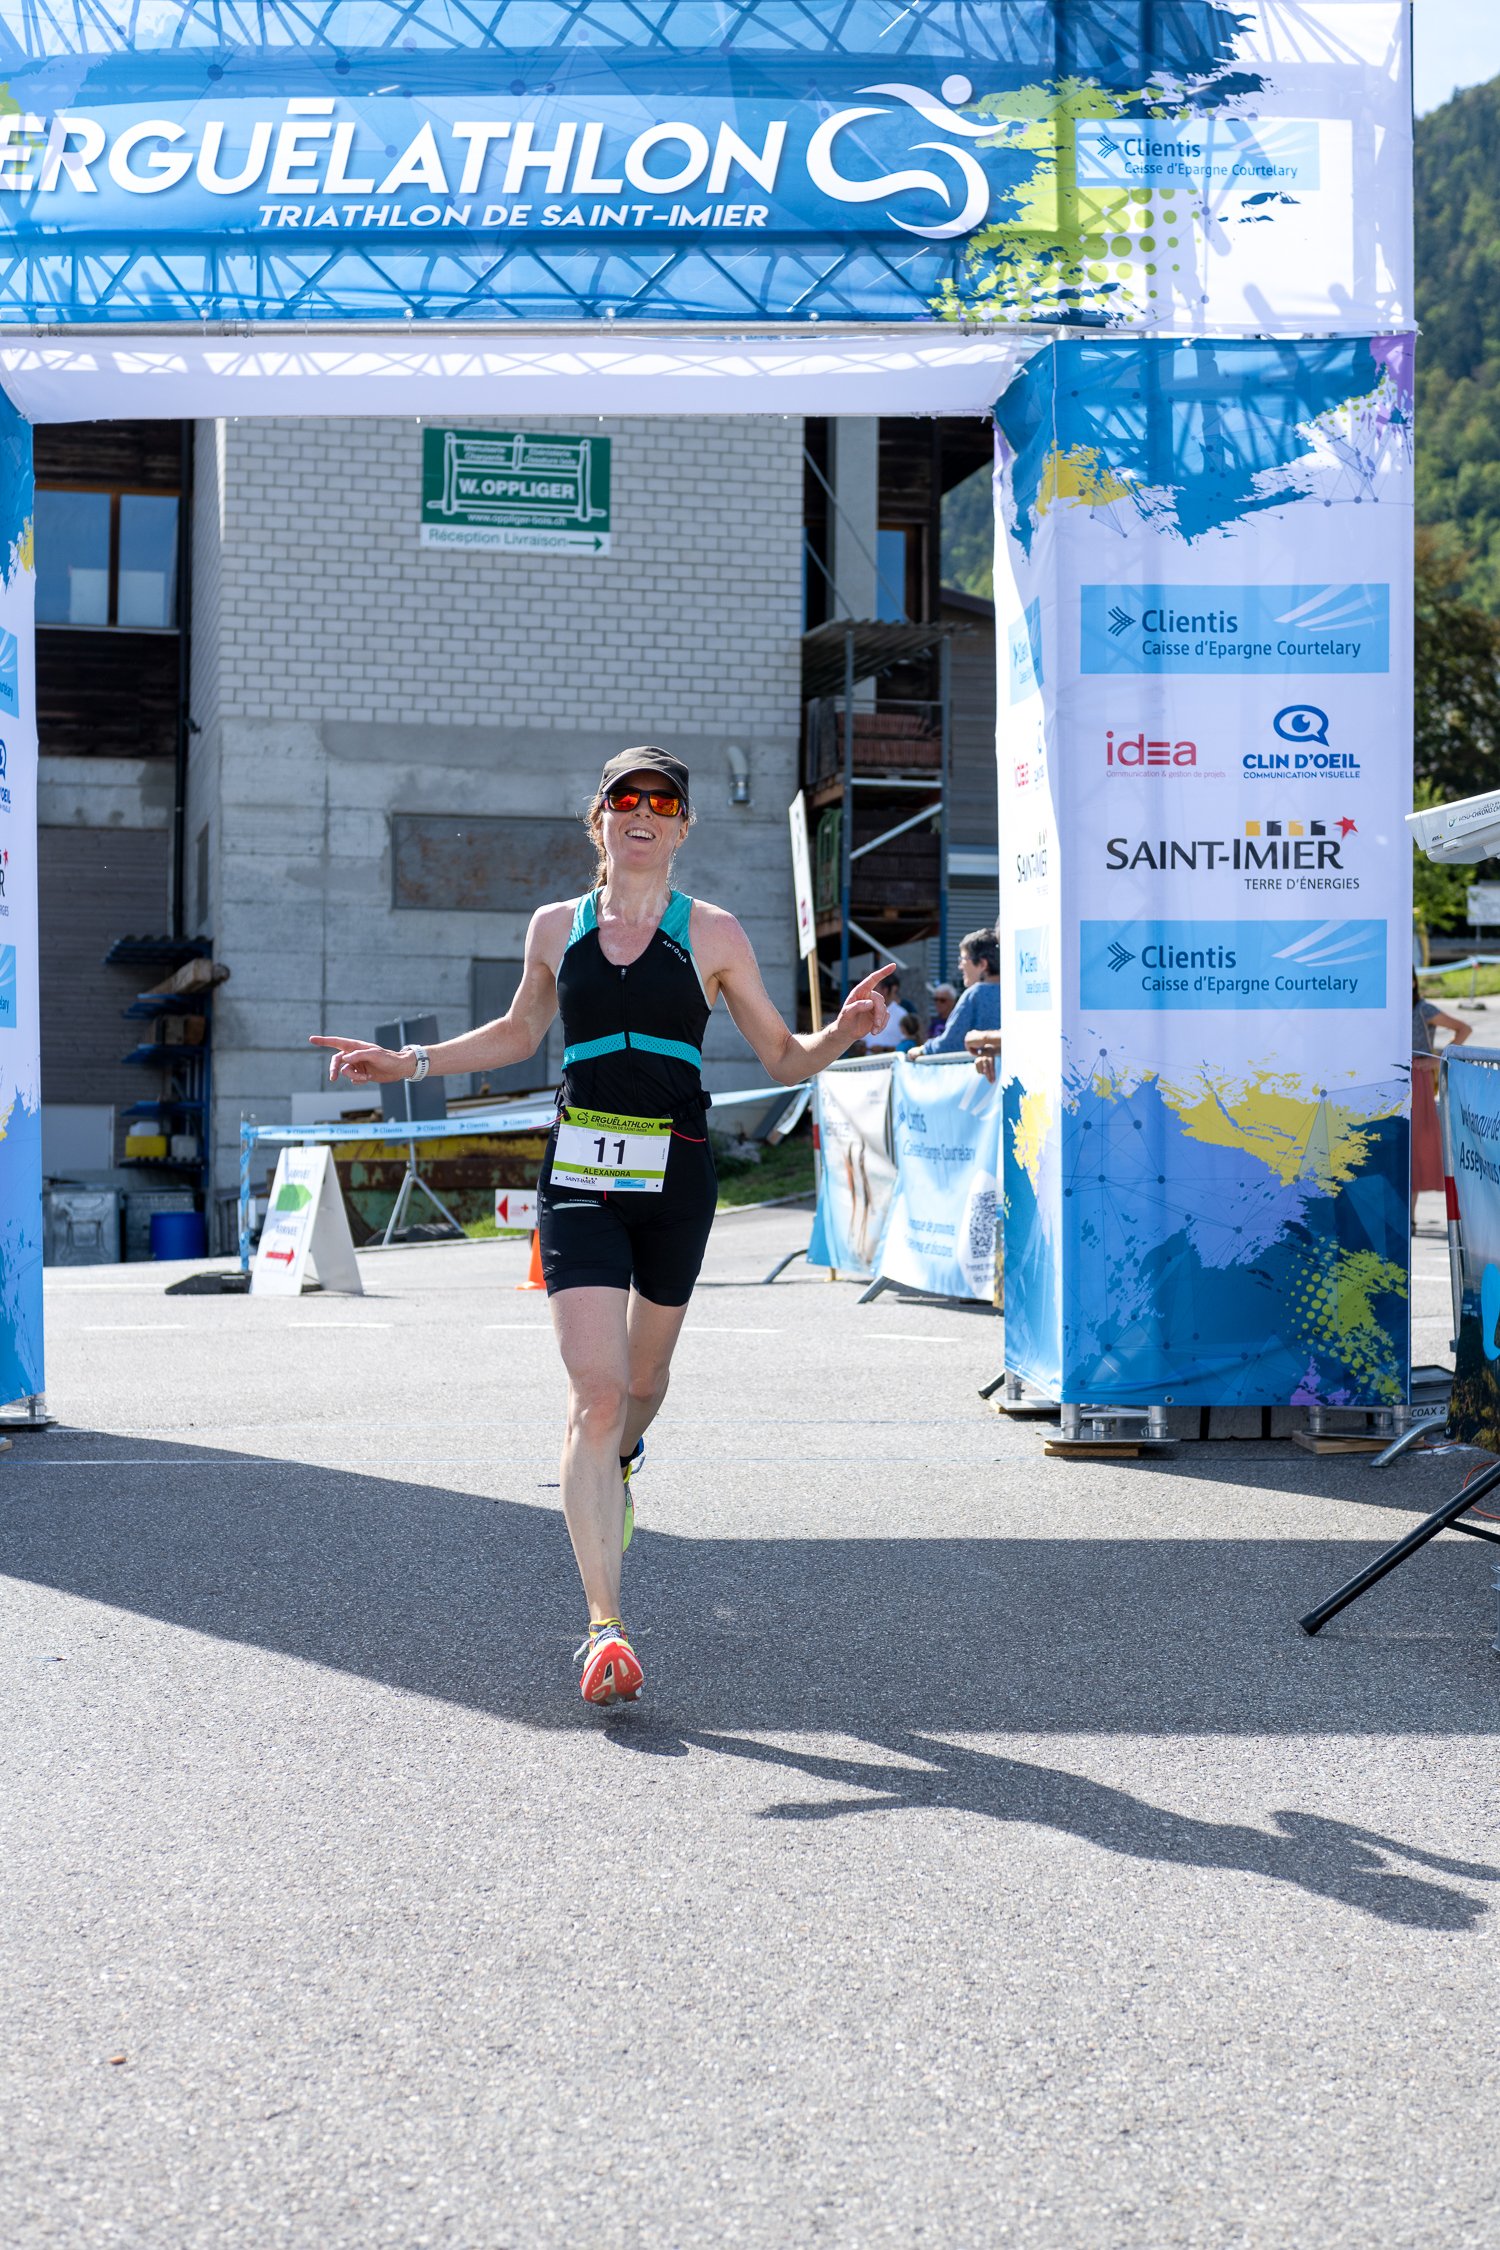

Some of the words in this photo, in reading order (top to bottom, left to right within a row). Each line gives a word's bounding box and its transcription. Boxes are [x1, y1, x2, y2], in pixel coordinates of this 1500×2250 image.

[1124, 138, 1199, 157] Clientis
[1124, 162, 1162, 177] Caisse
[1166, 162, 1227, 179] d'Epargne
[1232, 163, 1298, 180] Courtelary
[259, 205, 473, 227] TRIATHLON
[482, 205, 528, 227] DE
[541, 205, 768, 227] SAINT-IMIER
[429, 528, 499, 545] Réception
[504, 533, 567, 547] Livraison
[1141, 609, 1238, 633] Clientis
[1142, 639, 1190, 656] Caisse
[1194, 639, 1272, 659] d'Epargne
[1277, 640, 1361, 659] Courtelary
[1106, 731, 1197, 767] idea
[1242, 753, 1288, 769] CLIN
[1295, 752, 1360, 769] D'OEIL
[1106, 838, 1344, 870] SAINT-IMIER
[1244, 878, 1283, 889] TERRE
[1286, 876, 1360, 890] D'ÉNERGIES
[1141, 944, 1237, 969] Clientis
[1141, 974, 1189, 992] Caisse
[1193, 974, 1270, 994] d'Epargne
[1274, 974, 1358, 994] Courtelary
[593, 1136, 626, 1165] 11
[583, 1167, 631, 1177] ALEXANDRA
[1411, 1407, 1437, 1418] COAX
[1440, 1405, 1446, 1415] 2
